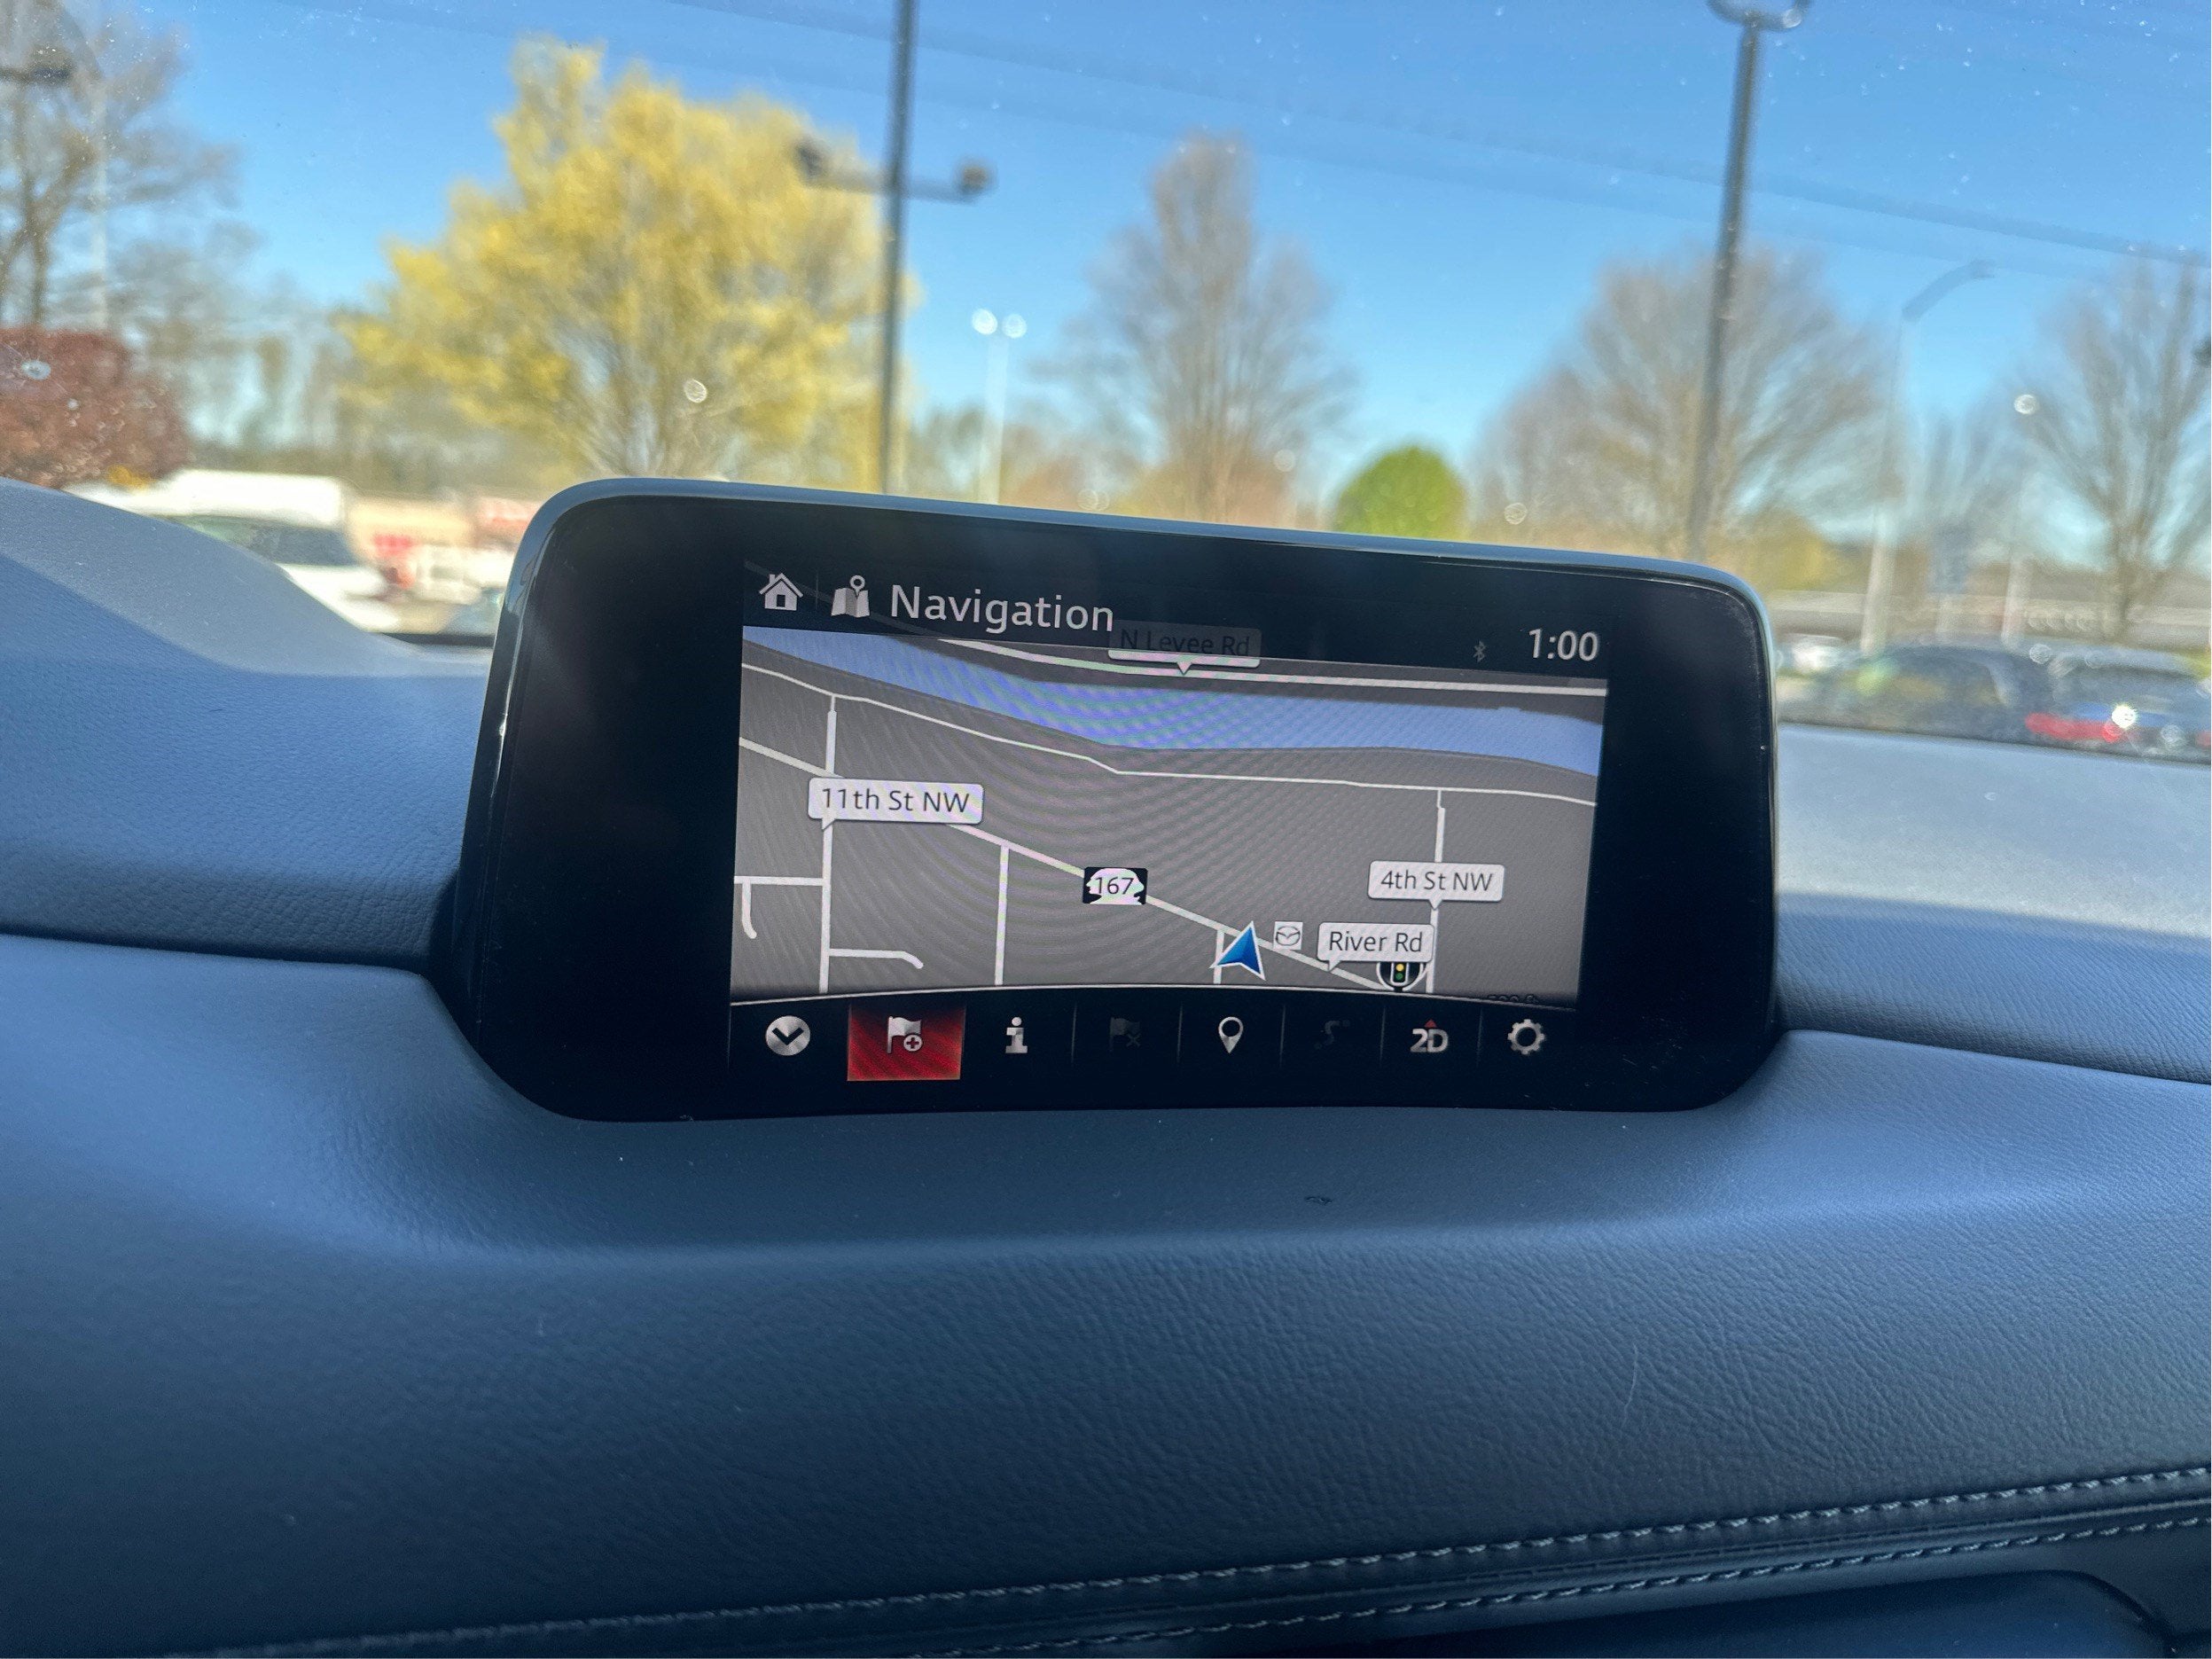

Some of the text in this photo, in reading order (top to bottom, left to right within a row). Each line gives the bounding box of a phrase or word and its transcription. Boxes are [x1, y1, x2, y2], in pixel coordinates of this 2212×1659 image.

[890, 584, 1114, 634] Navigation
[1121, 629, 1138, 649] N
[1222, 636, 1250, 656] Rd
[1528, 628, 1600, 661] 1:00
[821, 788, 970, 813] 11th St NW
[1095, 876, 1134, 895] 167
[1380, 870, 1493, 891] 4th St NW
[1329, 931, 1423, 952] River Rd
[1410, 1028, 1450, 1053] 2D
